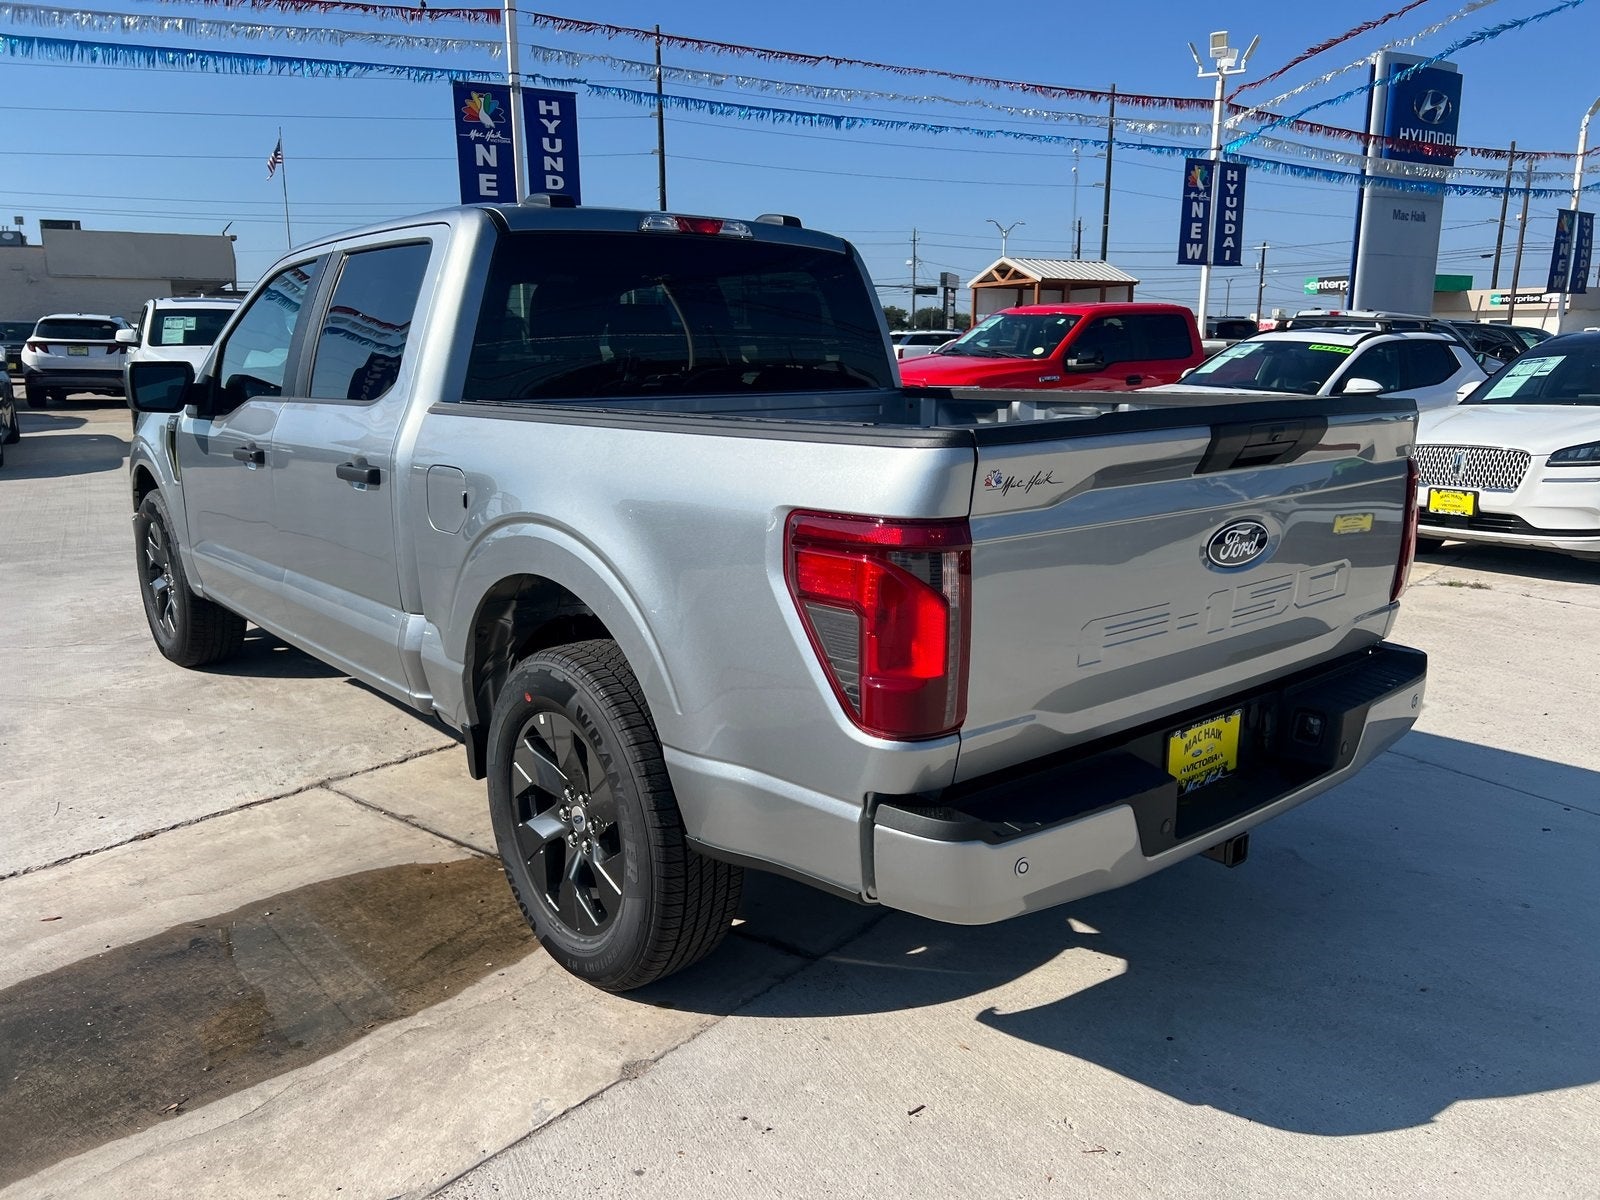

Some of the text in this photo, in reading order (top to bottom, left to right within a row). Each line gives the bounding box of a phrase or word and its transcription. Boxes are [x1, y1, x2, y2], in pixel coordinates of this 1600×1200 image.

[1400, 127, 1456, 146] HYUNDAI
[1222, 169, 1238, 261] HYUNDAI
[1392, 209, 1426, 222] Mac Haik
[1186, 201, 1204, 260] NEW
[987, 470, 1063, 496] Mac Haik
[1219, 528, 1259, 561] Ford
[1077, 558, 1352, 668] F-150
[1183, 734, 1203, 755] MAC
[1204, 727, 1223, 741] HAIK
